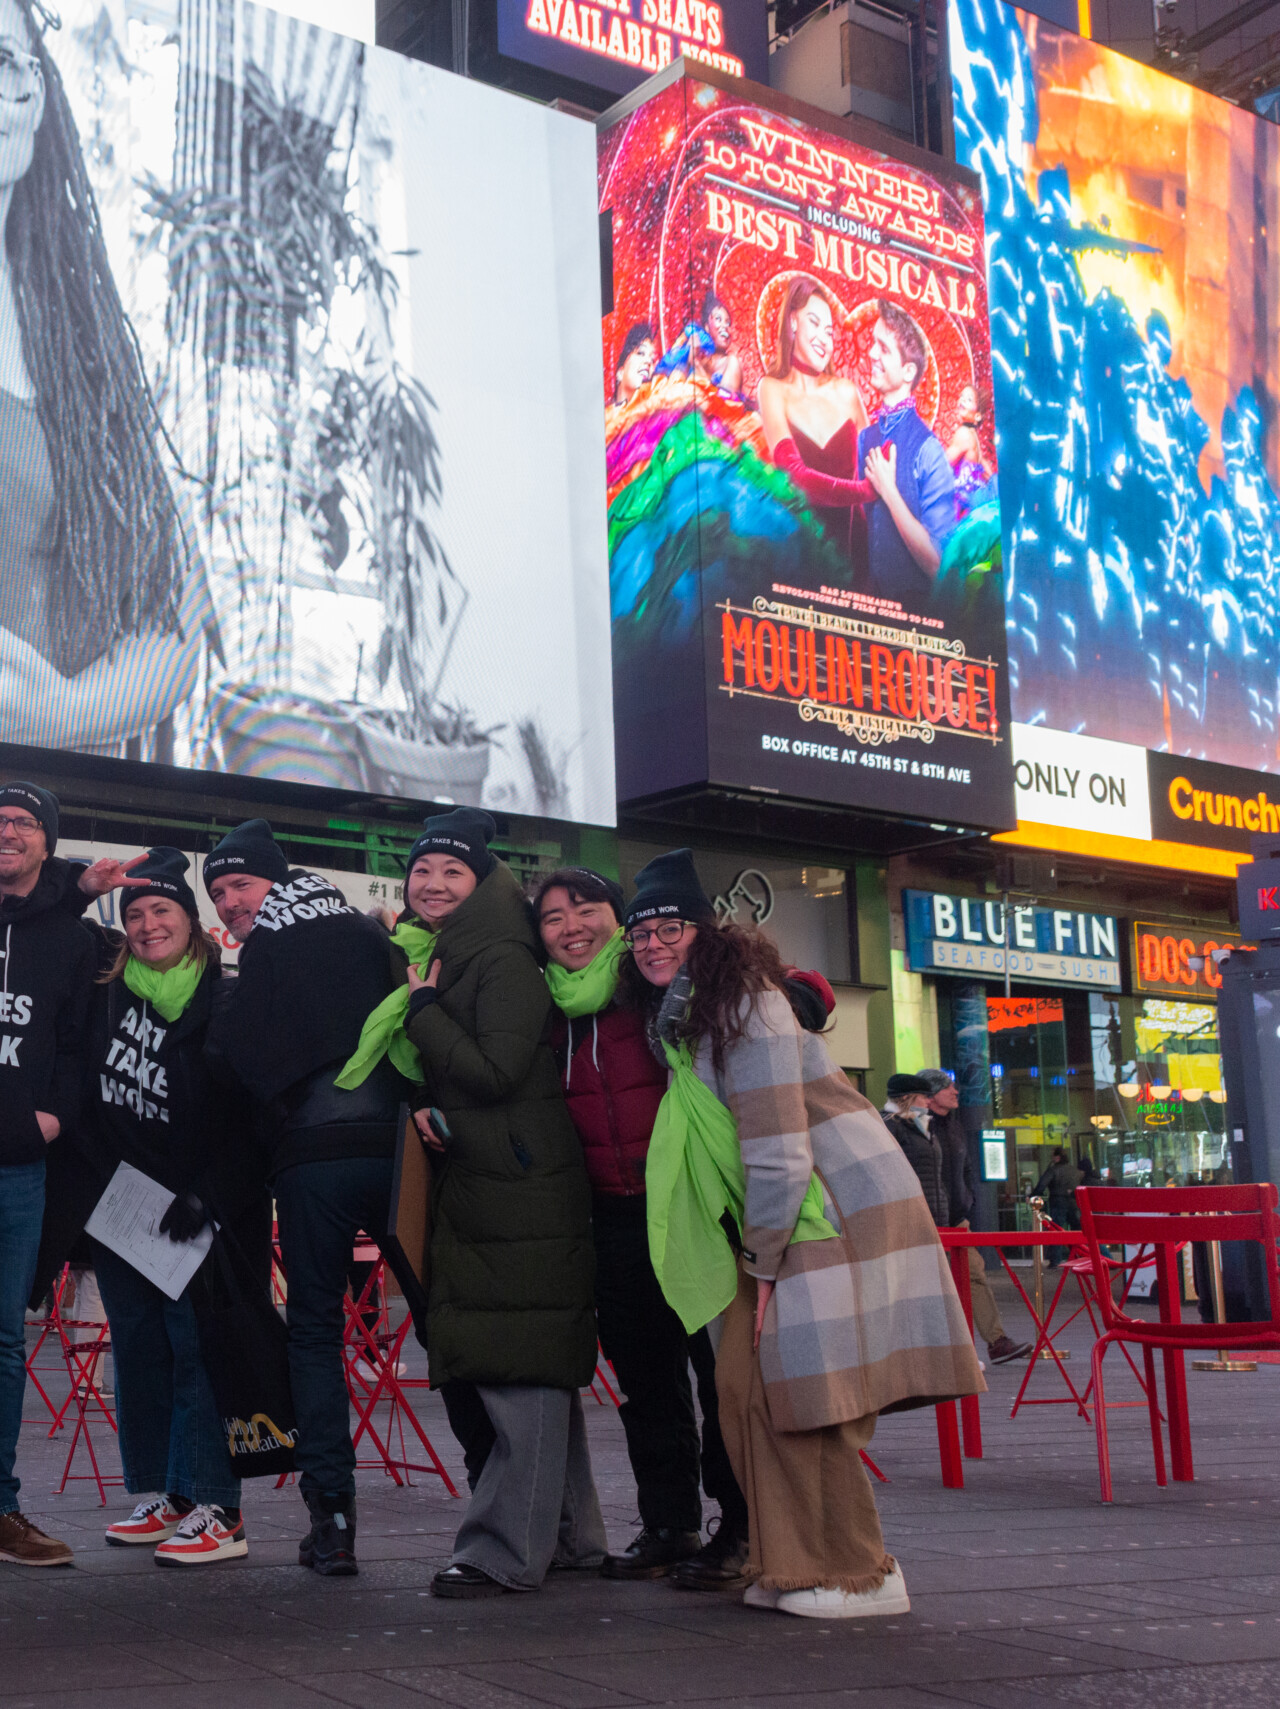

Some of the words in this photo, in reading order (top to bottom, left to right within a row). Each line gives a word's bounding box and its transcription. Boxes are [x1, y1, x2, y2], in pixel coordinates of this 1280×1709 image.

[528, 0, 671, 73] AVAILABLE
[643, 0, 721, 46] SEATS
[740, 117, 940, 217] WINNER!
[704, 140, 736, 170] 10
[741, 153, 837, 206] TONY
[839, 196, 975, 257] AWARDS
[807, 205, 881, 245] INCLUDING
[704, 190, 802, 260] BEST
[811, 228, 976, 319] MUSICAL!
[722, 612, 863, 709] MOULIN
[871, 643, 997, 733] ROUGE!
[823, 707, 849, 724] THE
[761, 734, 789, 753] BOX
[792, 740, 838, 762] OFFICE
[841, 749, 857, 764] AT
[859, 752, 891, 771] 45TH
[893, 758, 908, 775] ST
[910, 761, 920, 775] &
[922, 762, 945, 780] 8TH
[947, 767, 971, 784] AVE
[1015, 759, 1080, 799] ONLY
[1089, 774, 1126, 807] ON
[1168, 776, 1280, 833] Crunch
[368, 881, 387, 899] #1
[635, 907, 656, 919] TAKES
[658, 905, 679, 914] WORK
[933, 894, 1036, 948] BLUE
[1053, 910, 1116, 957] FIN
[938, 946, 1034, 972] SEAFOOD
[1059, 960, 1117, 982] SUSHI
[1143, 934, 1197, 985] DOS
[120, 1007, 167, 1052] ART
[106, 1038, 168, 1099] TAKE
